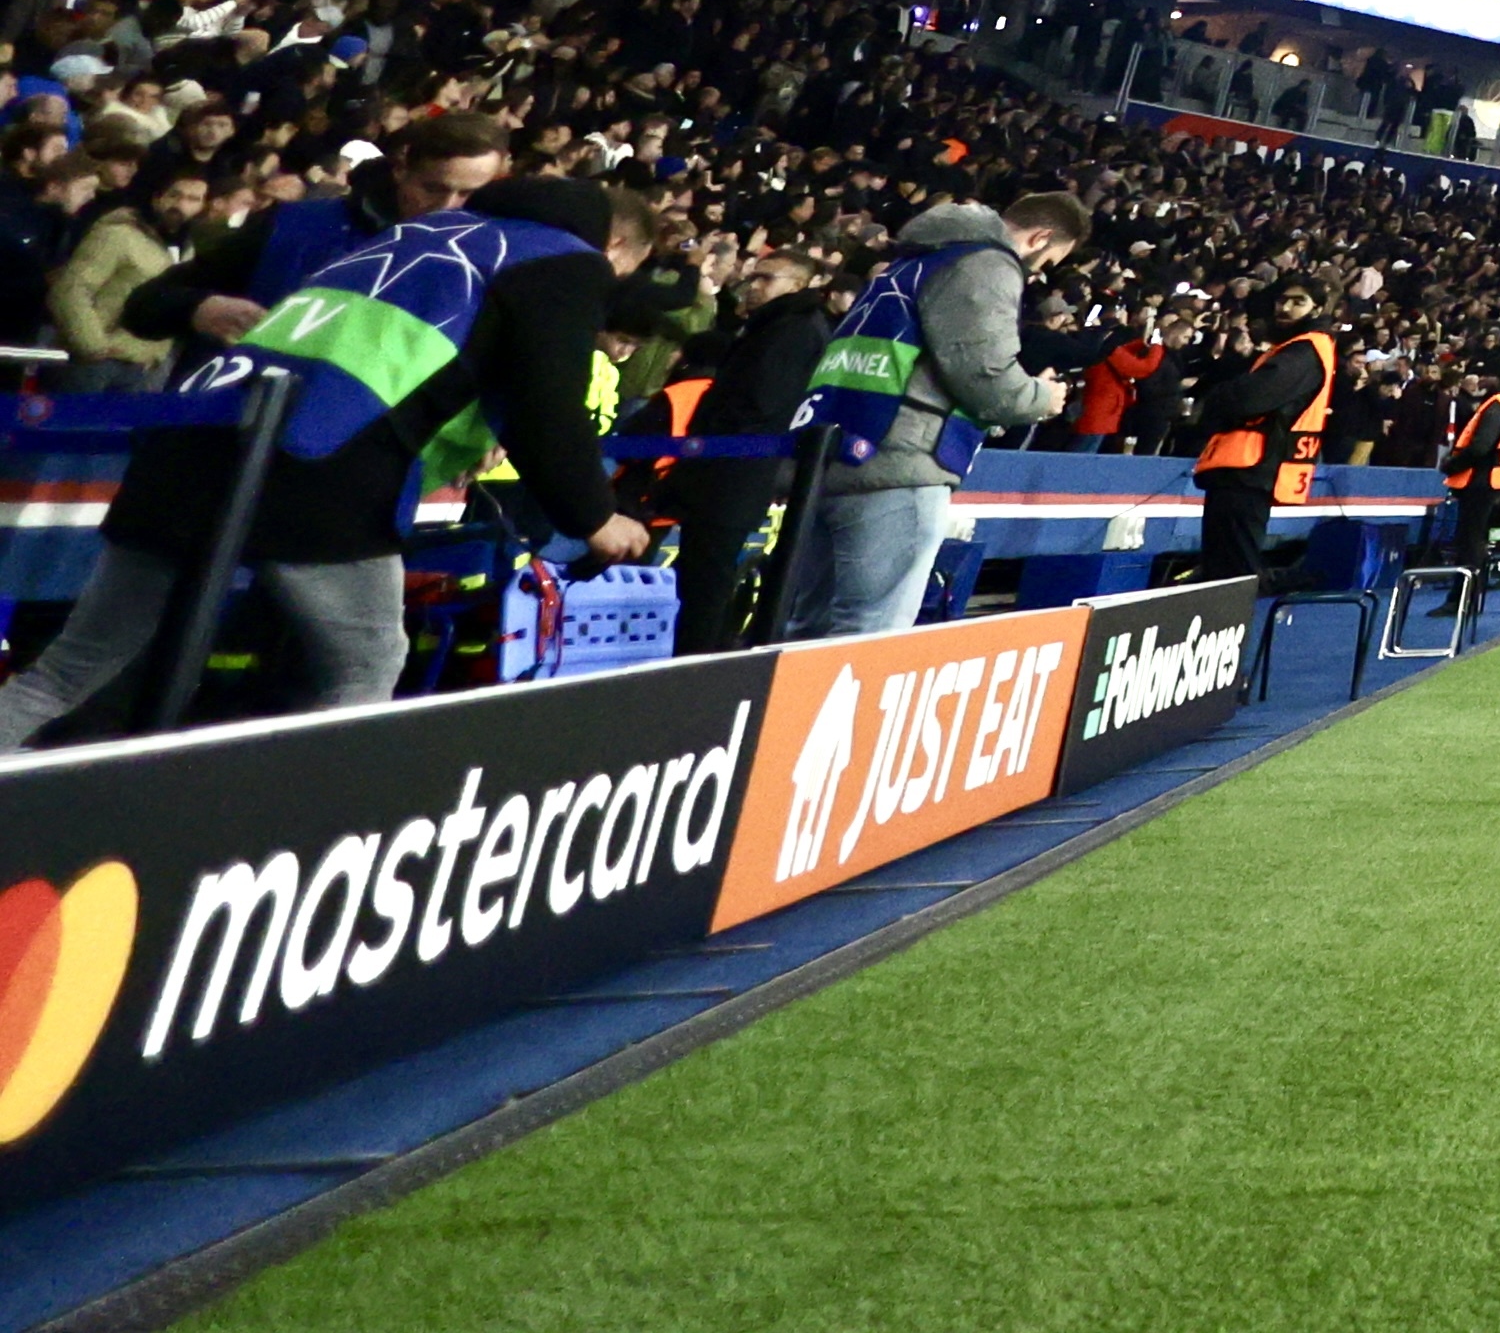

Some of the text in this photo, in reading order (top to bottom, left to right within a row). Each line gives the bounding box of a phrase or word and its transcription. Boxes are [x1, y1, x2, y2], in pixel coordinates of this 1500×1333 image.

[255, 295, 347, 342] TV
[819, 347, 891, 379] HANNEL
[1098, 614, 1246, 735] FollowScores
[838, 641, 1063, 865] JUST EAT
[141, 698, 752, 1060] mastercard
